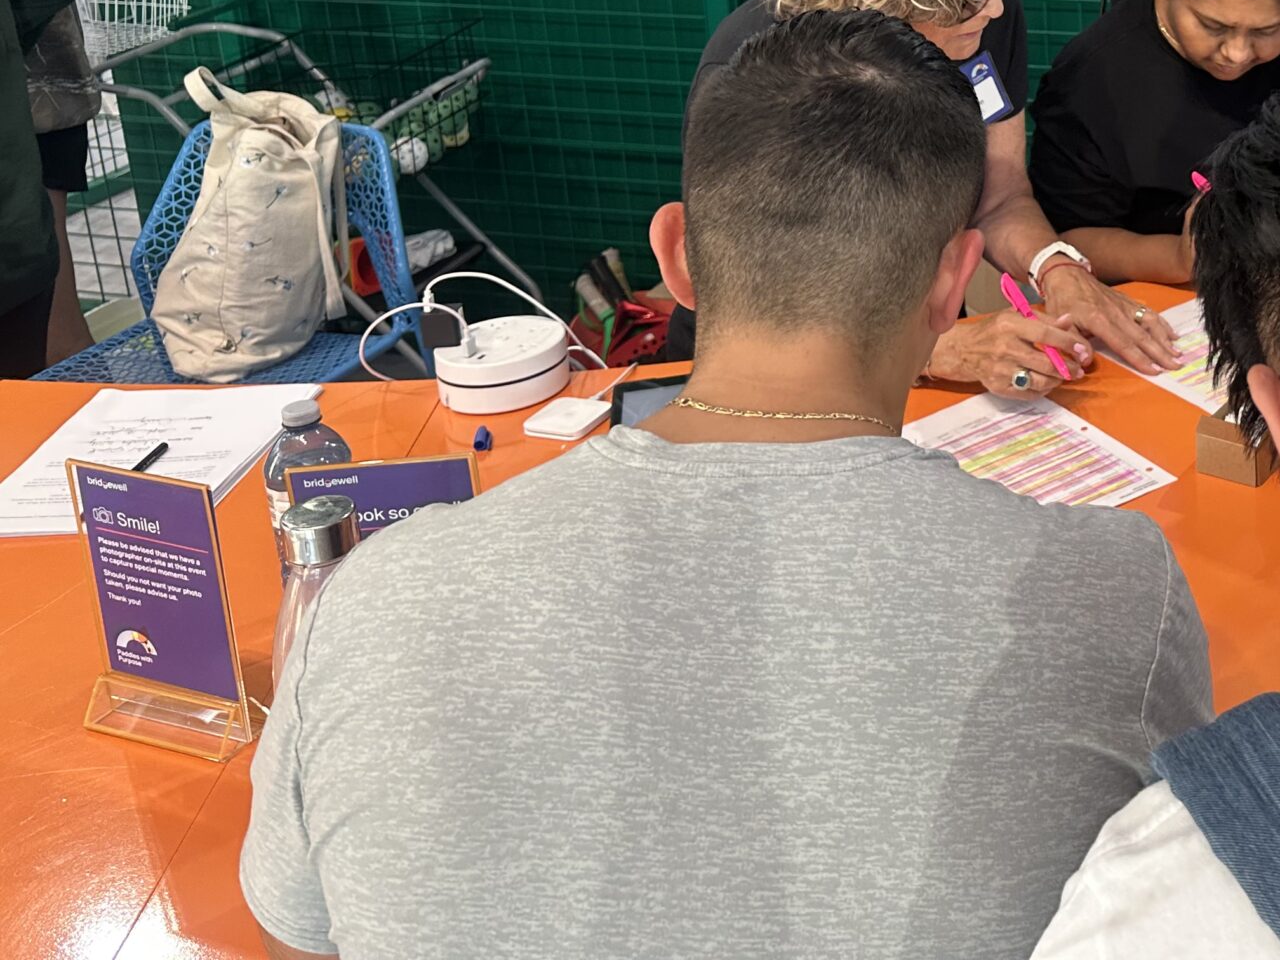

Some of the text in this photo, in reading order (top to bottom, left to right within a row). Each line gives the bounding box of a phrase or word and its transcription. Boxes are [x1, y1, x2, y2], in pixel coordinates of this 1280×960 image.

[86, 475, 128, 492] bridgewell
[303, 475, 359, 488] bridgewell
[117, 512, 161, 534] Smile!
[388, 508, 410, 520] so
[98, 536, 119, 548] Please
[120, 542, 129, 550] be
[129, 544, 154, 556] advised
[155, 549, 168, 559] that
[169, 553, 179, 561] we
[179, 554, 195, 564] have
[100, 546, 207, 577] photographer on-site at this event
[109, 557, 134, 569] capture
[135, 562, 157, 574] special
[158, 568, 190, 581] moments.
[103, 568, 203, 598] Should you not want your photo
[105, 578, 179, 602] taken, please advise us.
[107, 591, 142, 606] Thank you!
[116, 648, 154, 664] Paddles with
[118, 654, 143, 667] Purpose
